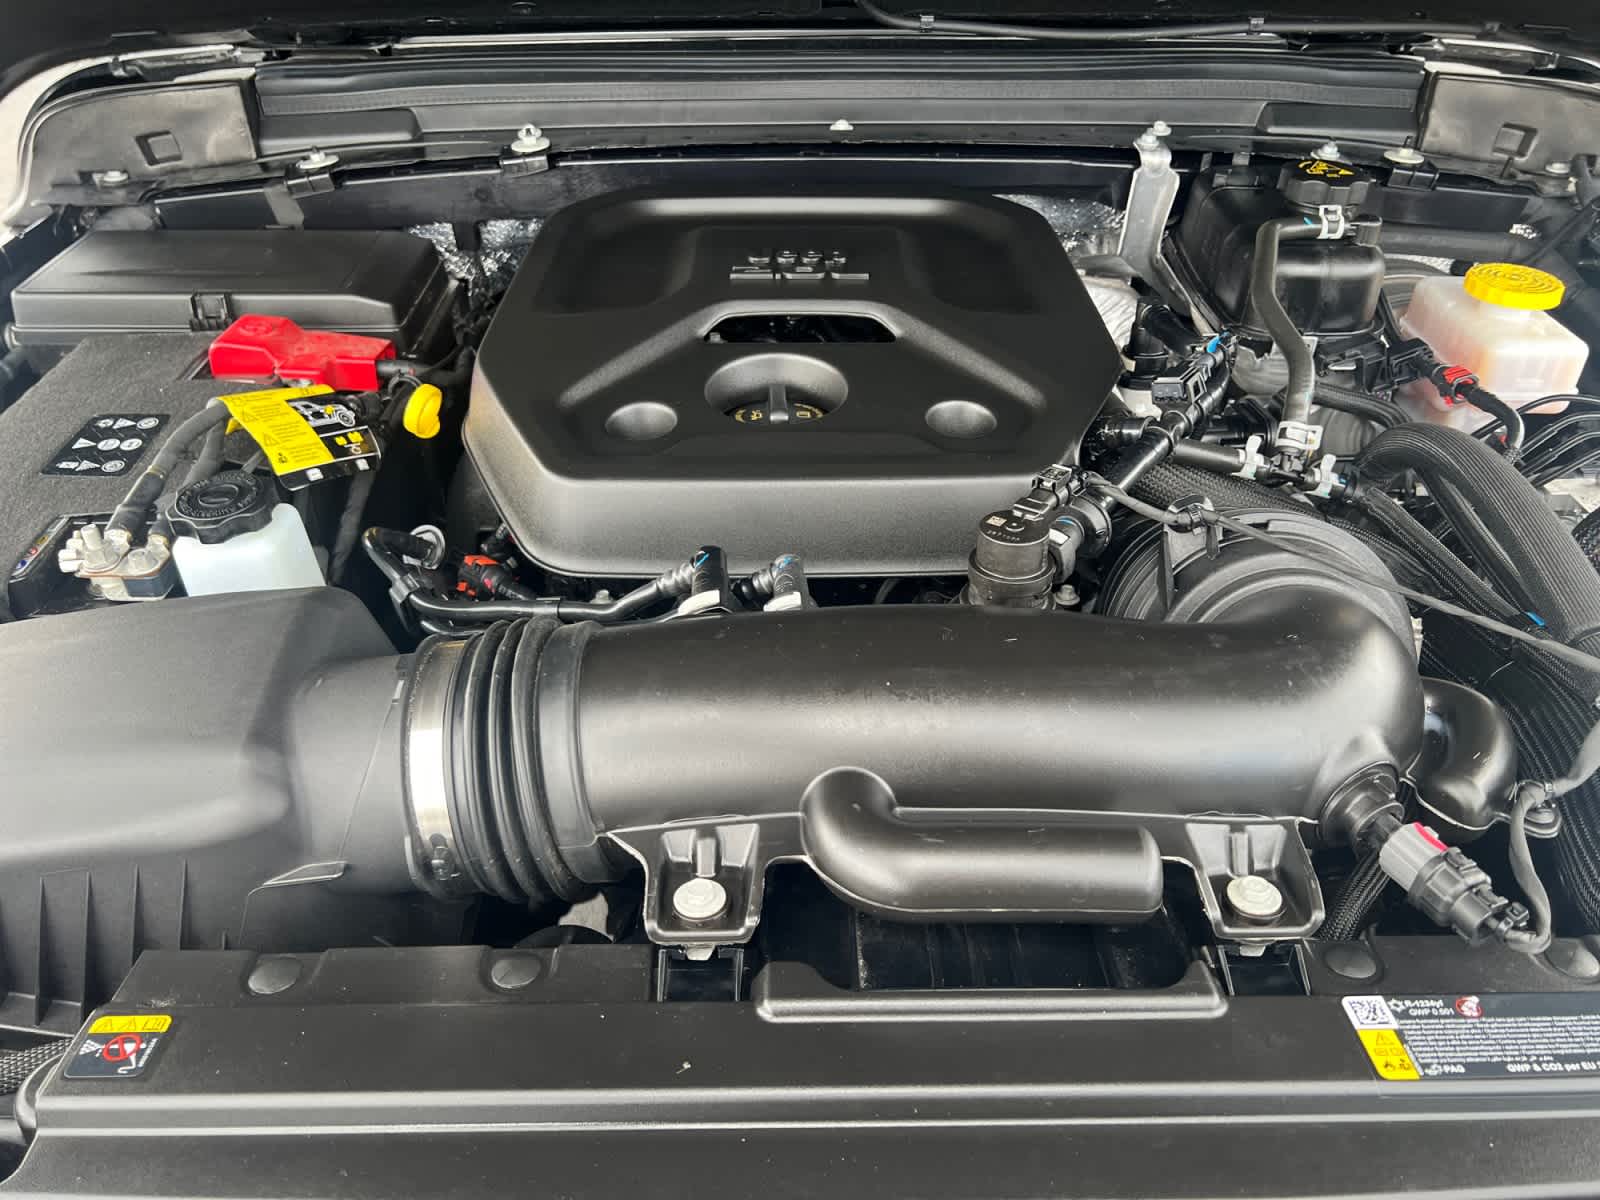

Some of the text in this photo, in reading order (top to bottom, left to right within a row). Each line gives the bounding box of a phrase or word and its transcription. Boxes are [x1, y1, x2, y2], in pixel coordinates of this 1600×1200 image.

[1506, 1064, 1532, 1073] GWP
[1565, 1062, 1582, 1073] per
[1582, 1061, 1597, 1071] EU
